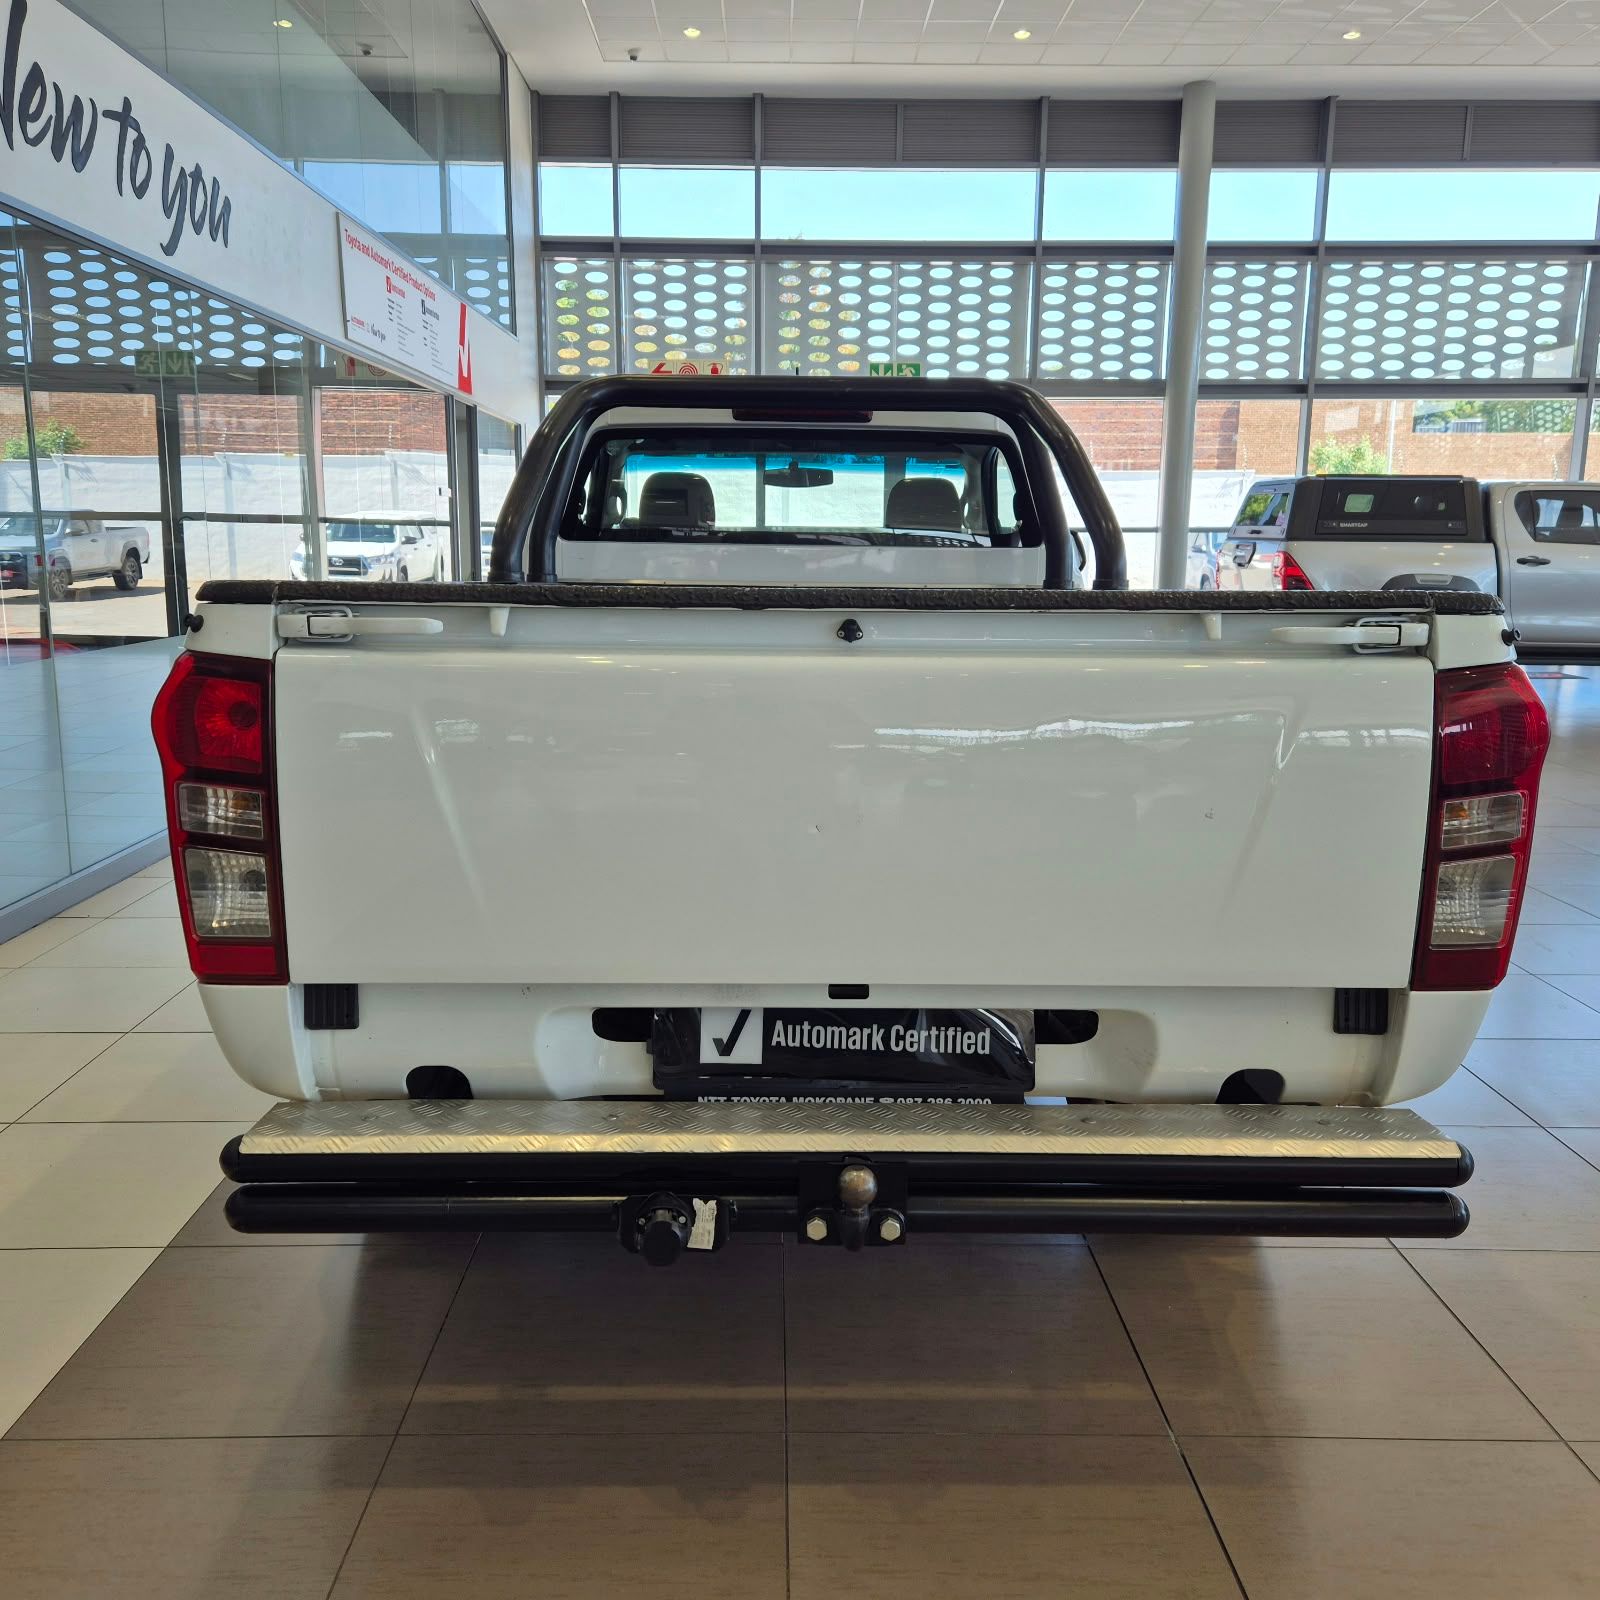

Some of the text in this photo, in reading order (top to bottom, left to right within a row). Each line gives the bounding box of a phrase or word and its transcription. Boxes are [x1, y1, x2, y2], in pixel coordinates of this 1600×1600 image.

[102, 97, 152, 200] to
[160, 142, 231, 256] you
[345, 228, 361, 249] Toyota
[771, 1020, 991, 1055] Automark Certified
